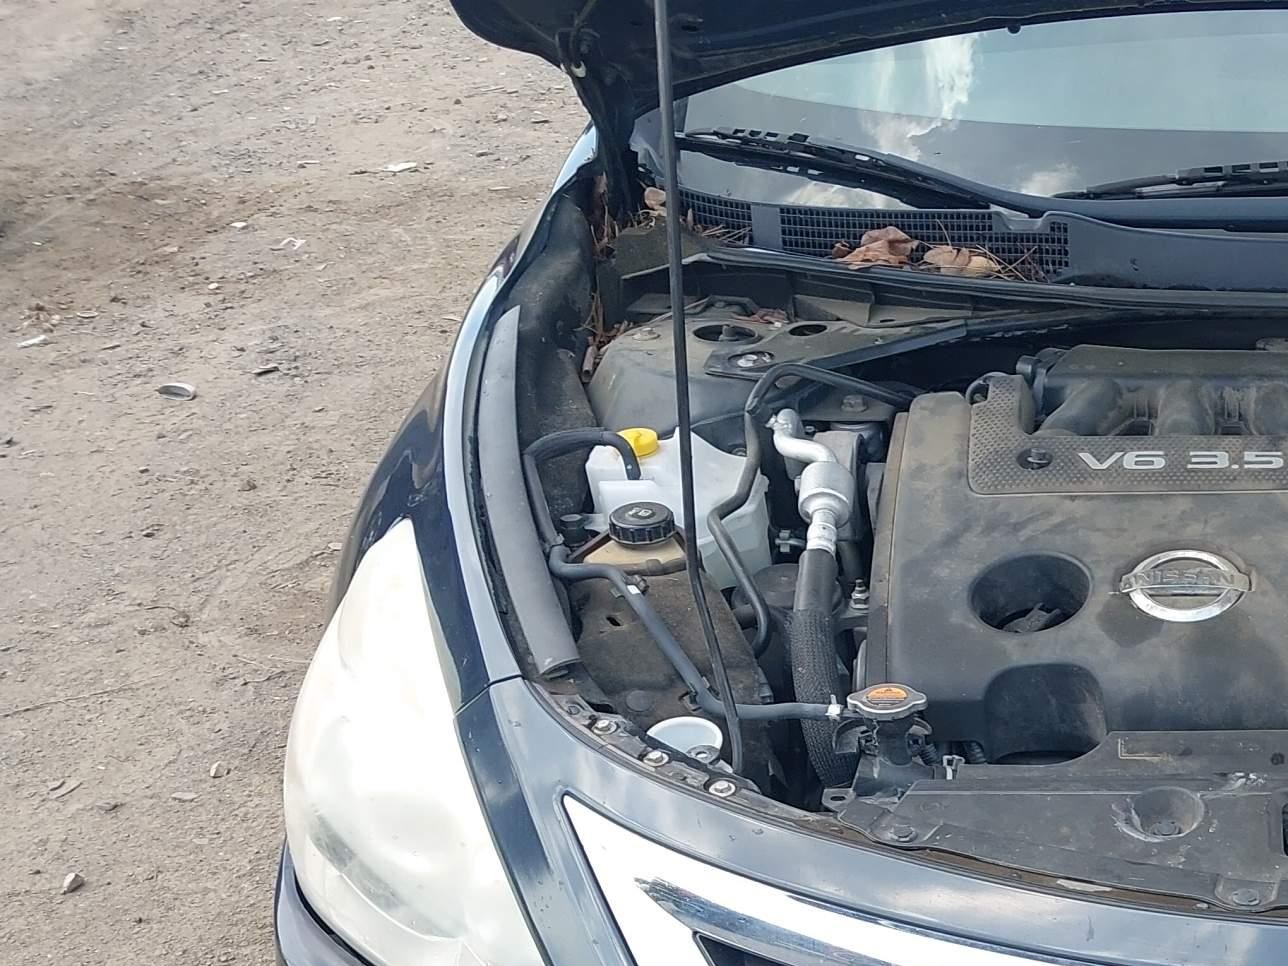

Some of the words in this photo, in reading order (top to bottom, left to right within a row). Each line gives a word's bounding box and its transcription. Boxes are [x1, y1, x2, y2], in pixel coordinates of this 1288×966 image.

[1078, 451, 1166, 470] V6
[1187, 450, 1285, 469] 3.5
[1138, 572, 1235, 586] NISSAN
